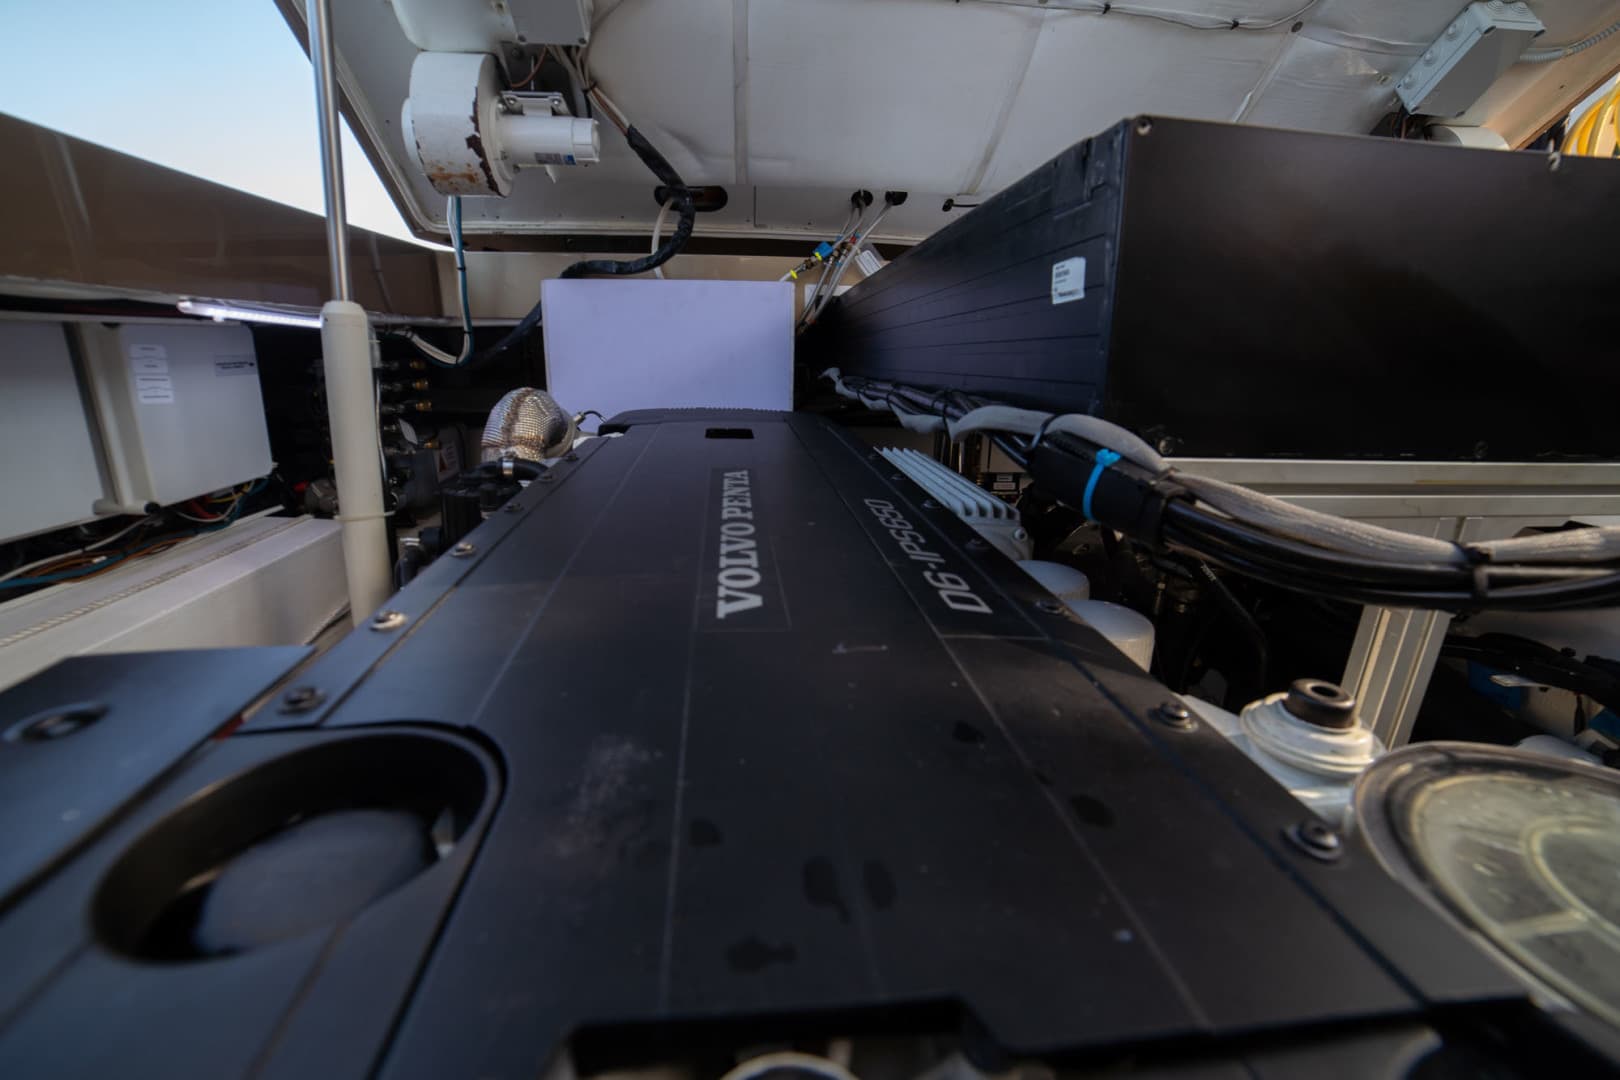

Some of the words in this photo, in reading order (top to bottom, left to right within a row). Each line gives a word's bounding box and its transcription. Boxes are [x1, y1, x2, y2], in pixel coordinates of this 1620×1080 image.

[721, 470, 753, 521] PENTA
[716, 522, 764, 620] VOLVO
[863, 498, 993, 615] D6-IPS650
